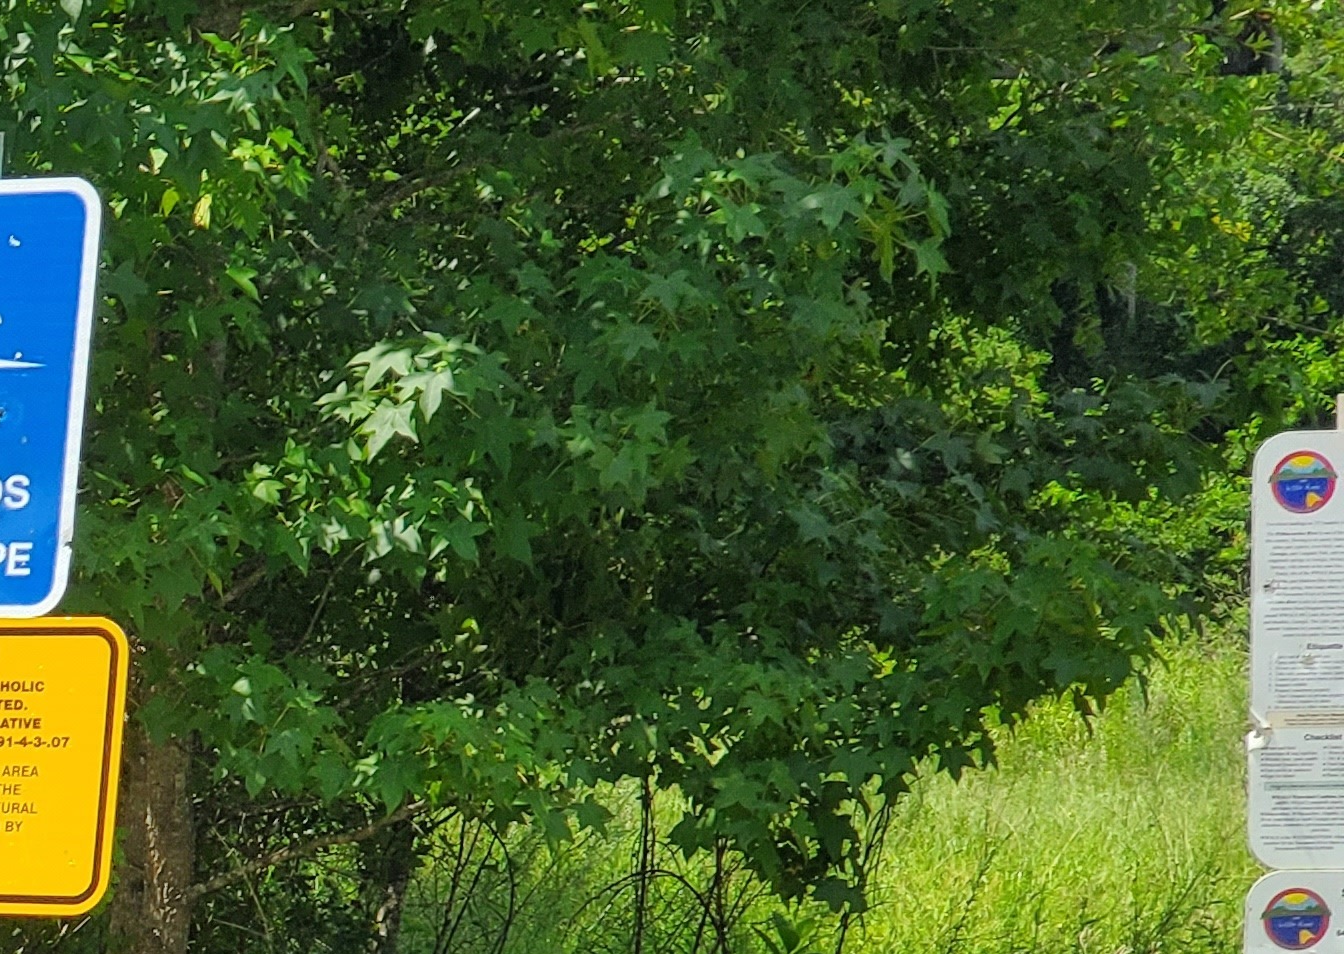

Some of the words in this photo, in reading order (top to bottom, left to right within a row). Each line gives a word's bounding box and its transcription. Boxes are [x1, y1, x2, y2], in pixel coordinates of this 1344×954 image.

[1304, 733, 1343, 741] Checklist
[2, 765, 39, 778] AREA
[5, 821, 23, 833] BY
